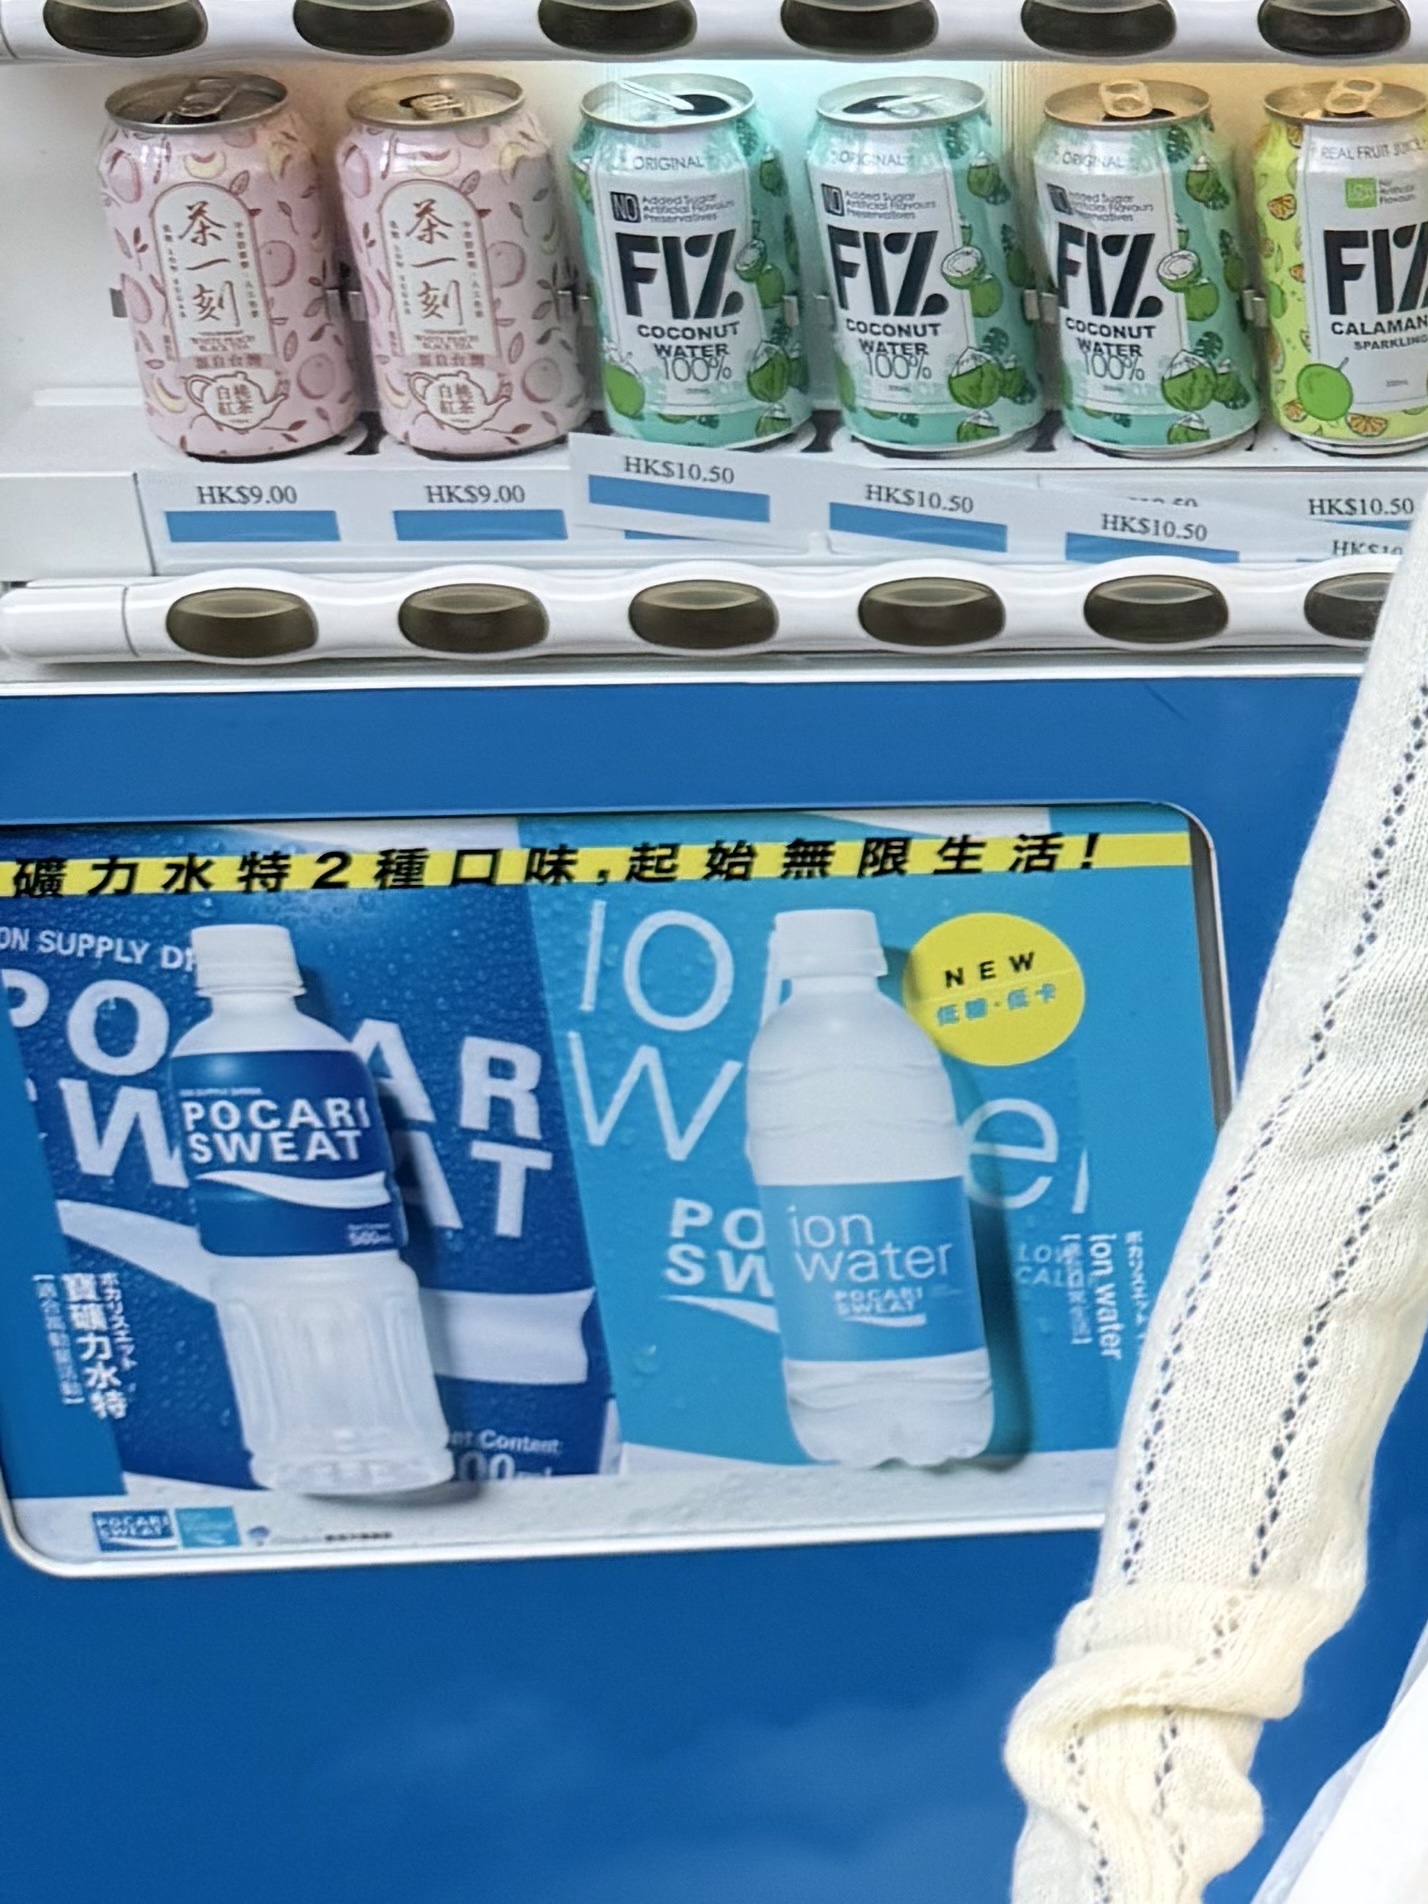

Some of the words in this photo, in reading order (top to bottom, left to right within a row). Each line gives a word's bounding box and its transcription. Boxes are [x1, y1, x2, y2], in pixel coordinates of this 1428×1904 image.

[180, 201, 236, 327] 茶一刻
[406, 200, 464, 326] 茶一刻
[616, 230, 743, 320] FIZ
[827, 224, 949, 316] FIZ
[1057, 222, 1163, 318] FIZ
[637, 323, 740, 339] COCONUT
[846, 320, 942, 337] COCONUT
[1354, 334, 1428, 351] SPARKLING
[653, 342, 728, 358] WATER
[860, 340, 929, 356] WATER
[662, 357, 732, 382] 100%
[625, 456, 734, 483] HK$10.50
[197, 486, 297, 505] HK$9.00
[425, 485, 525, 504] HK$9.00
[866, 485, 973, 513] HK$10.50
[1308, 498, 1414, 516] HK$10.50
[1103, 514, 1207, 540] HK$10.50
[38, 930, 150, 964] SUPPLY
[944, 951, 1036, 988] NEW
[182, 1098, 369, 1131] POCARI
[188, 1130, 360, 1163] SWEAT
[787, 1205, 873, 1247] ion
[794, 1241, 952, 1283] water
[61, 1272, 128, 1420] 寶礦力水特
